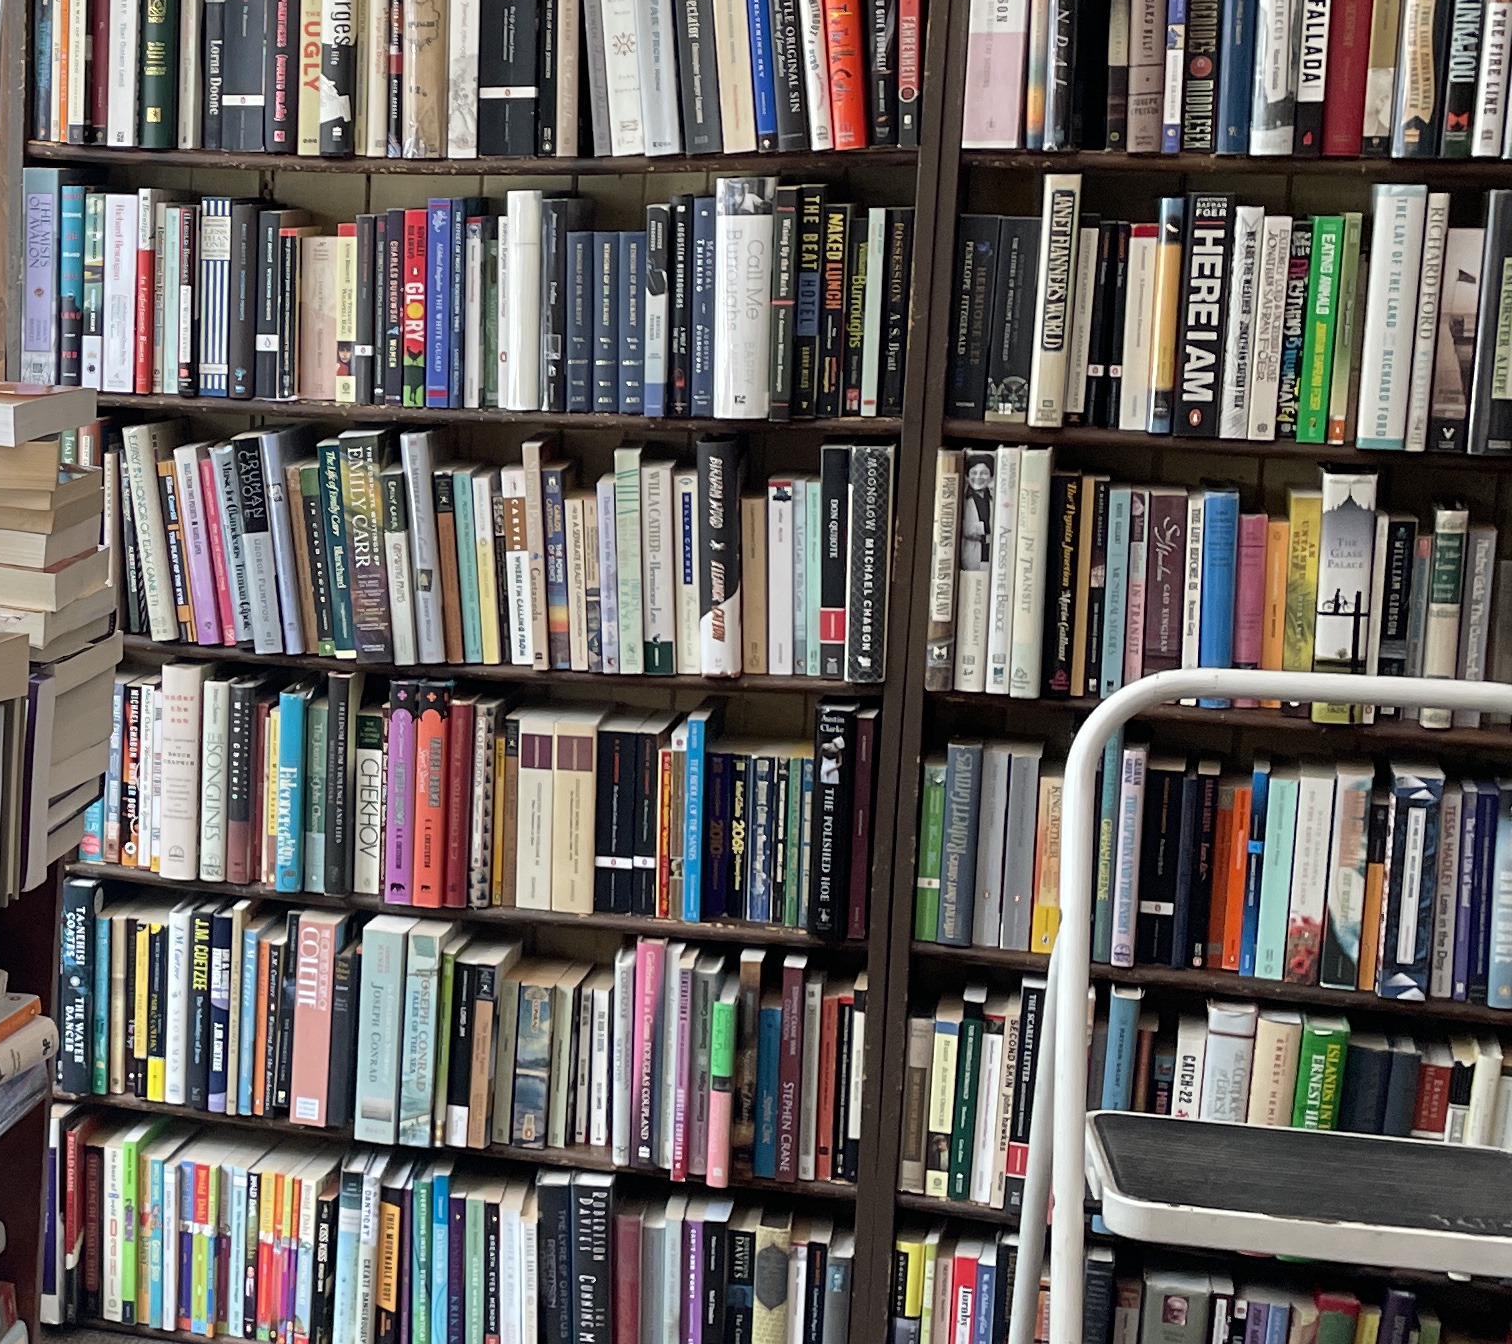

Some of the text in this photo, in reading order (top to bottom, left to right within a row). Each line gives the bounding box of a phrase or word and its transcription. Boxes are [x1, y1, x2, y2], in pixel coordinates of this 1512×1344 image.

[303, 21, 322, 93] UGLY
[900, 16, 916, 83] FAHRENHEIT
[801, 194, 821, 270] THE BEAT
[404, 282, 425, 343] GLORY
[799, 276, 817, 330] HOTEL
[1187, 229, 1226, 328] HERE
[1181, 343, 1217, 402] AM
[357, 756, 380, 865] CHEKHOV
[64, 1006, 74, 1053] DANCER
[72, 995, 85, 1065] THE WATER
